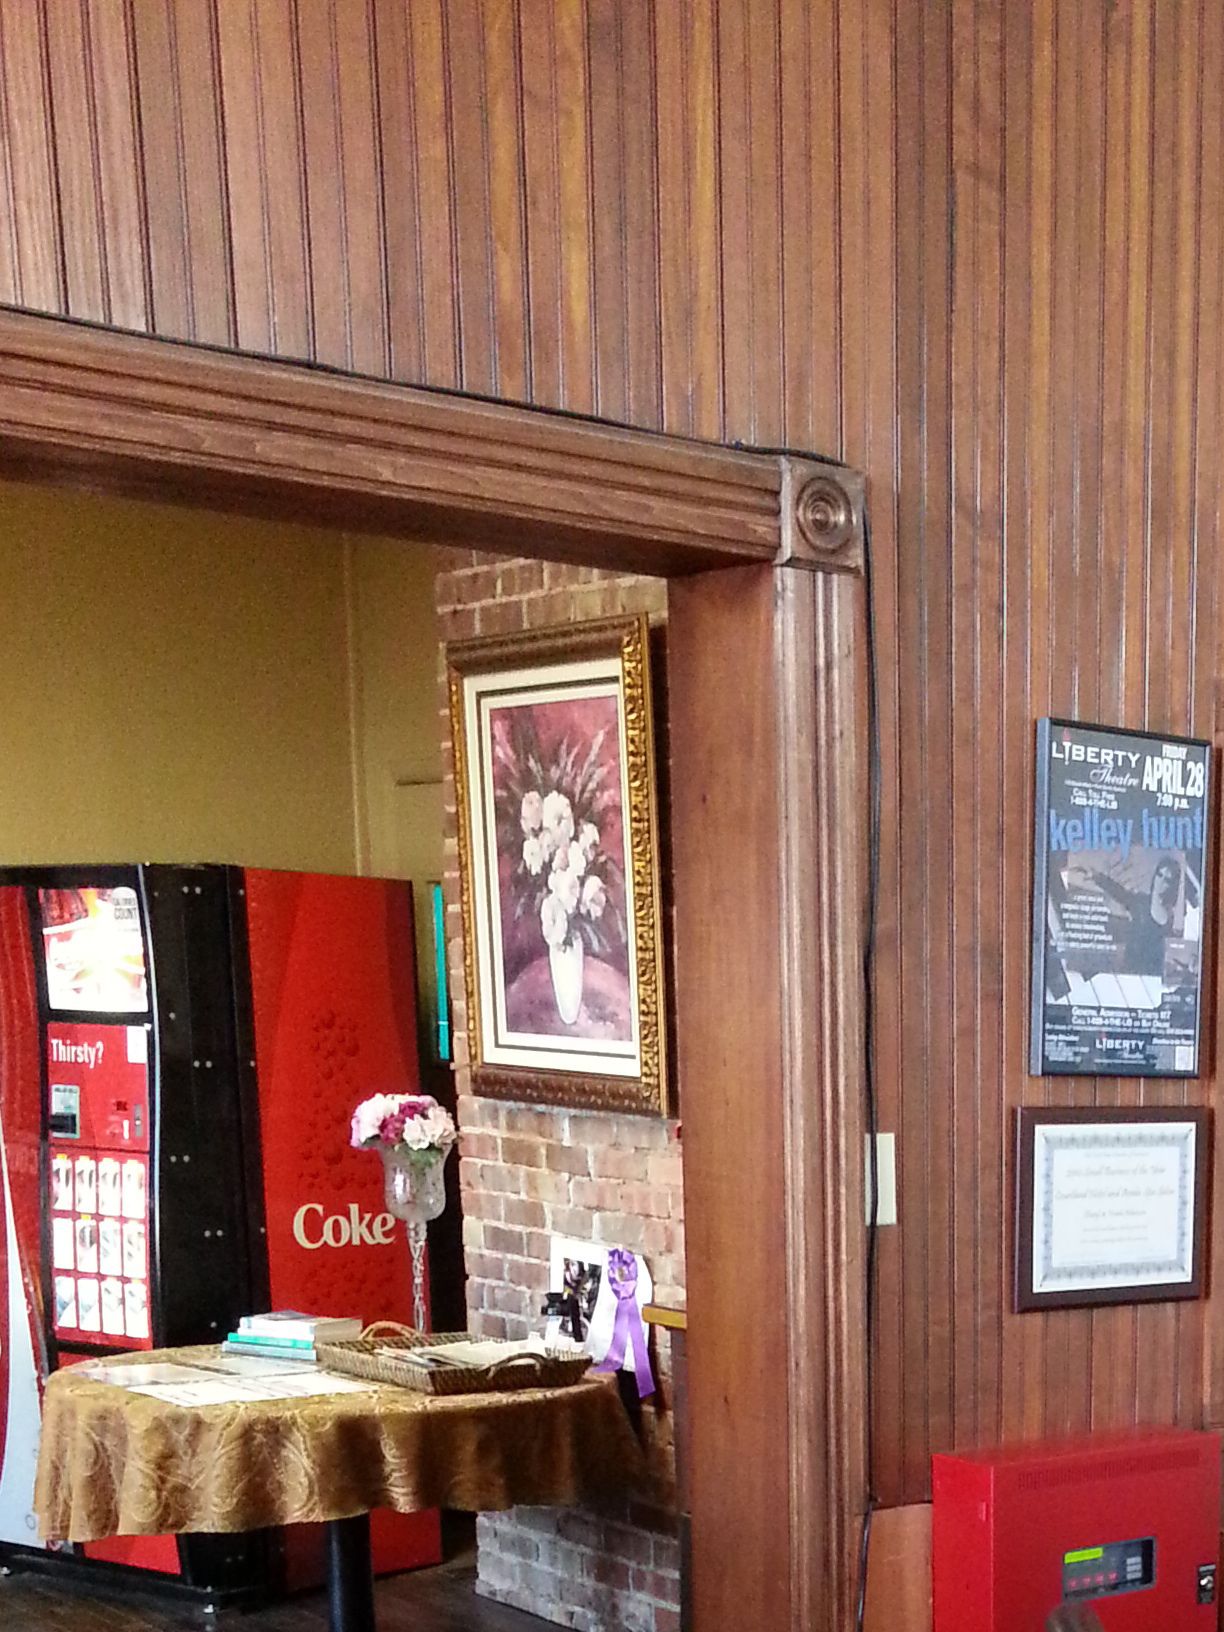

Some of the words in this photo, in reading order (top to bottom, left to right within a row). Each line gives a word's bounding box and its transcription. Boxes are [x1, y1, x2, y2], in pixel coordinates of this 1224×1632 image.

[1052, 740, 1141, 769] LIBERTY
[1089, 764, 1140, 788] Theatre
[1142, 755, 1185, 796] APRIL
[1185, 760, 1205, 798] 28
[1050, 806, 1134, 863] kelley
[1142, 806, 1204, 850] hunt
[50, 1038, 104, 1069] Thirsty?
[1095, 1038, 1145, 1051] LIBERTY
[293, 1203, 396, 1250] Coke
